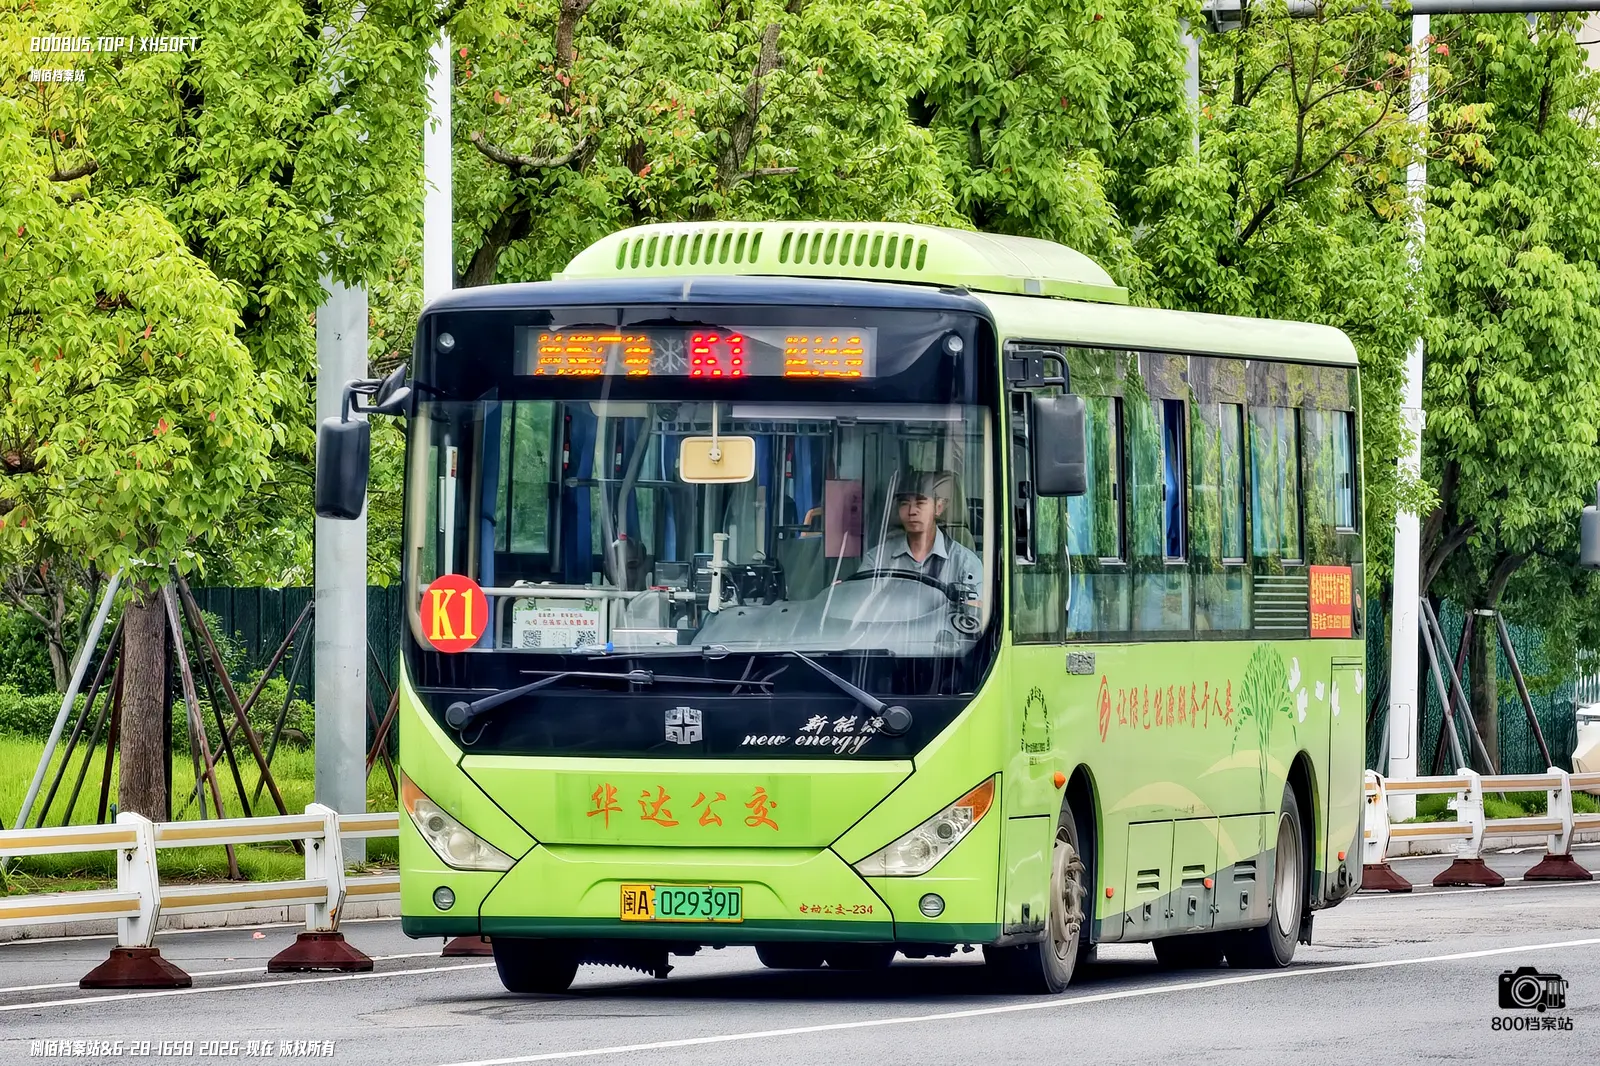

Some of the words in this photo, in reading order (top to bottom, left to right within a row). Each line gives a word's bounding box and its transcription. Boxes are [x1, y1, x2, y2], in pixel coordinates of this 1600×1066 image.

[429, 588, 477, 640] K1
[799, 714, 884, 735] 新能源
[740, 734, 790, 747] new
[793, 734, 873, 755] energy
[586, 782, 779, 831] 华达公交
